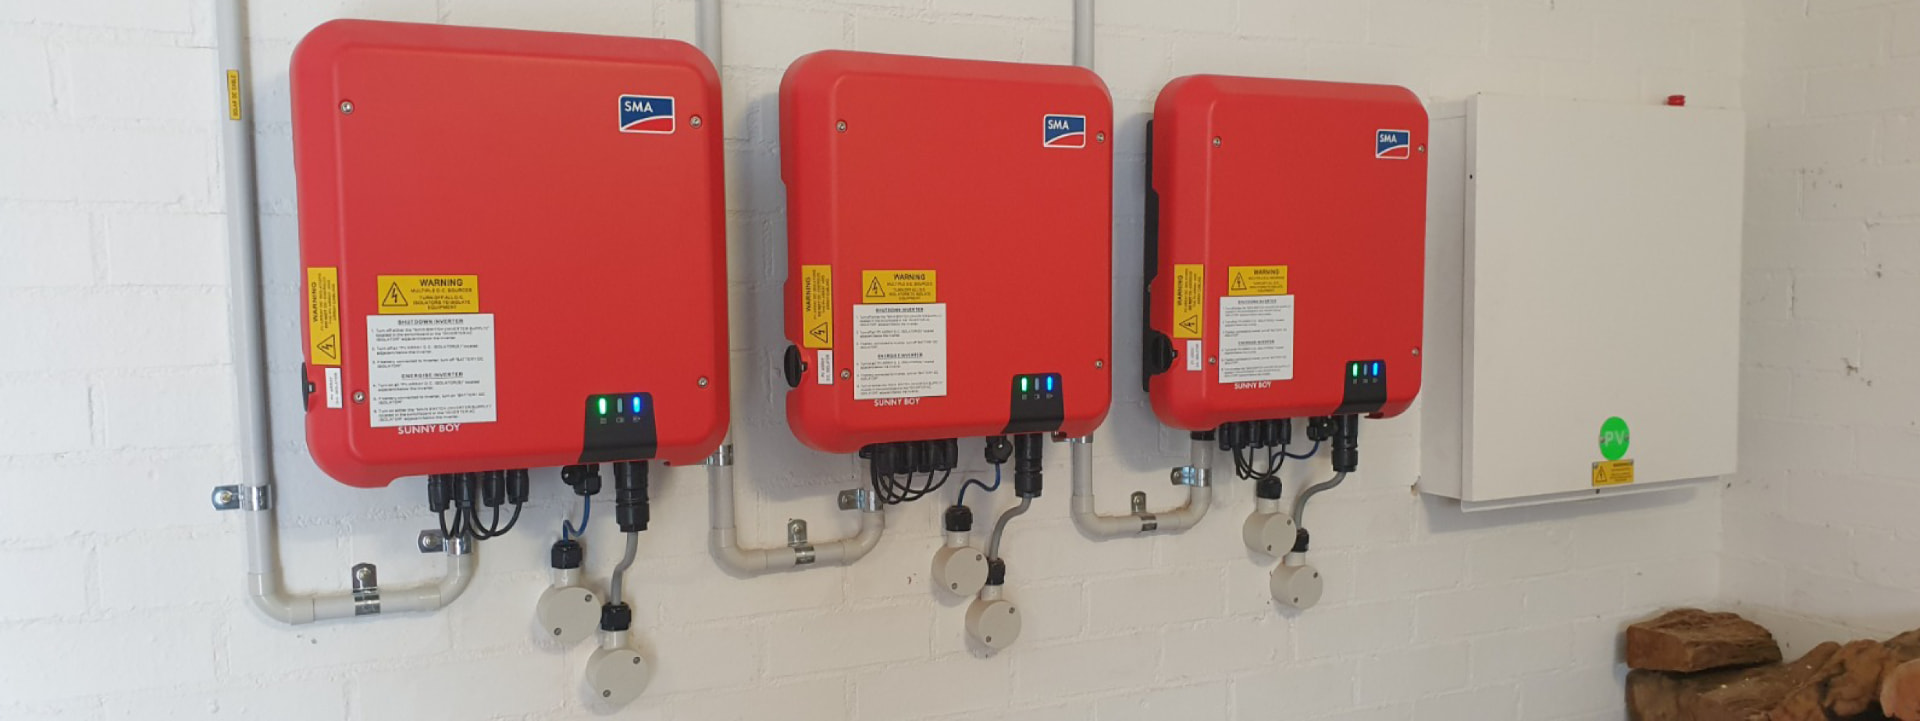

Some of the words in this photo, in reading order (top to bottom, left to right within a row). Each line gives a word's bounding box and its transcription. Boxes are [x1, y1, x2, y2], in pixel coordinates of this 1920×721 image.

[624, 100, 654, 112] SMA
[1048, 120, 1069, 130] SMA
[1380, 134, 1397, 143] SMA
[420, 278, 463, 286] WARNING
[874, 399, 902, 407] SUNNY
[398, 424, 436, 434] SUNNY
[439, 423, 460, 432] BOY
[1605, 431, 1625, 447] PV
